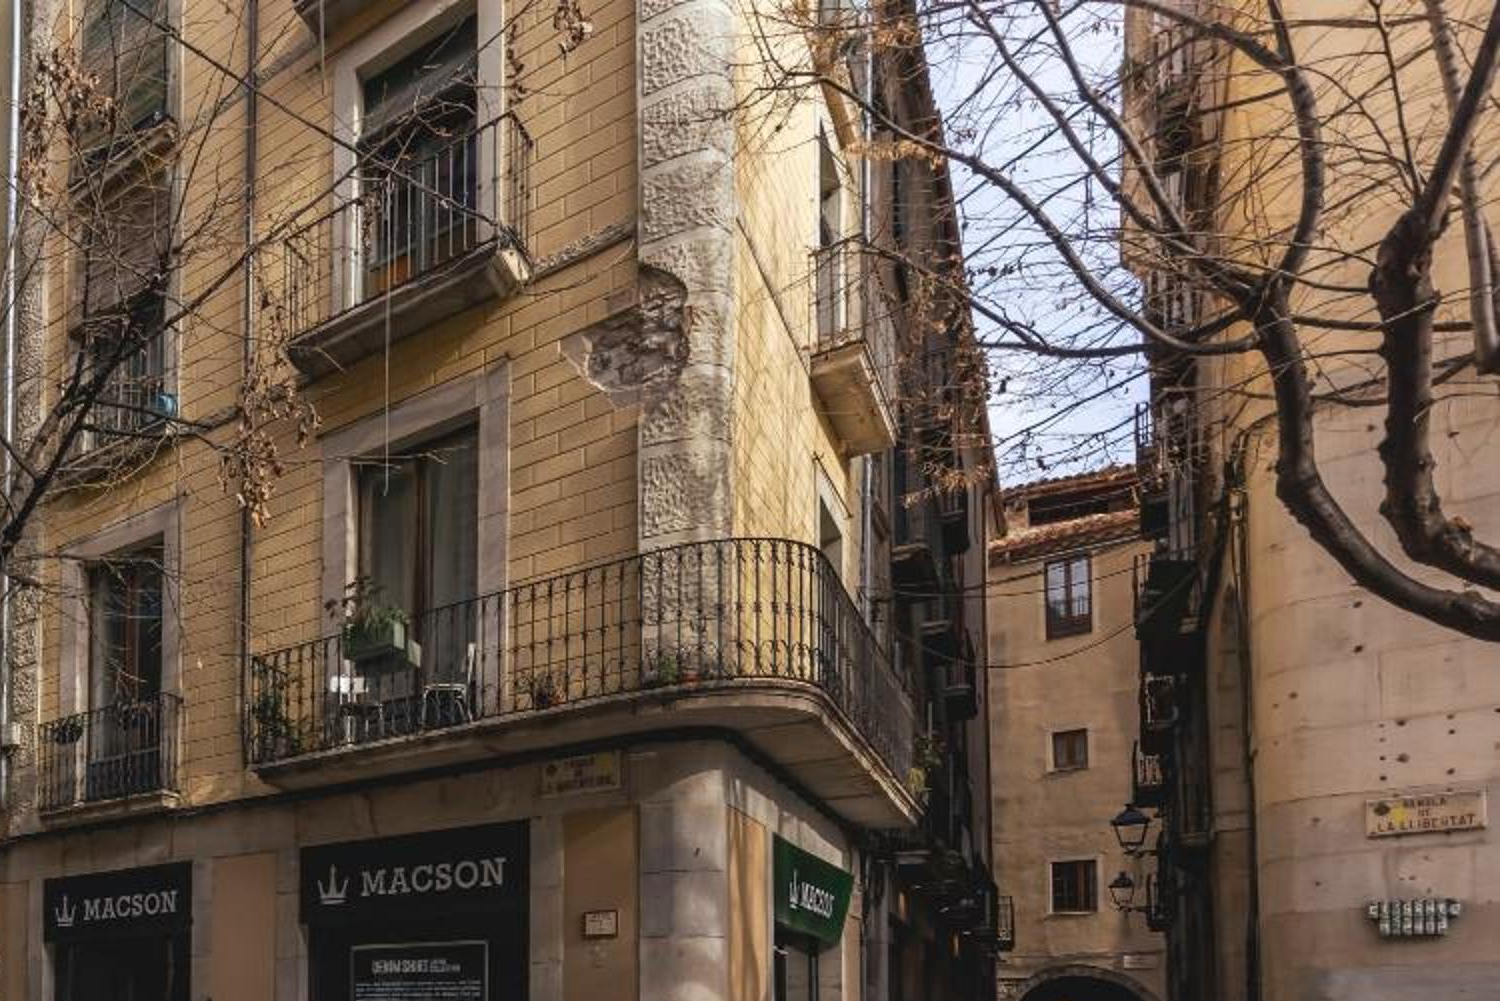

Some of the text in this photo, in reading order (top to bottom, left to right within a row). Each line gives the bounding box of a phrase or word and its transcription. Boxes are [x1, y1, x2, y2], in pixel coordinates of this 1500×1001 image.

[1377, 821, 1395, 833] LA
[362, 857, 506, 896] MACSON
[83, 890, 178, 920] MACSON
[800, 881, 835, 918] MACSON
